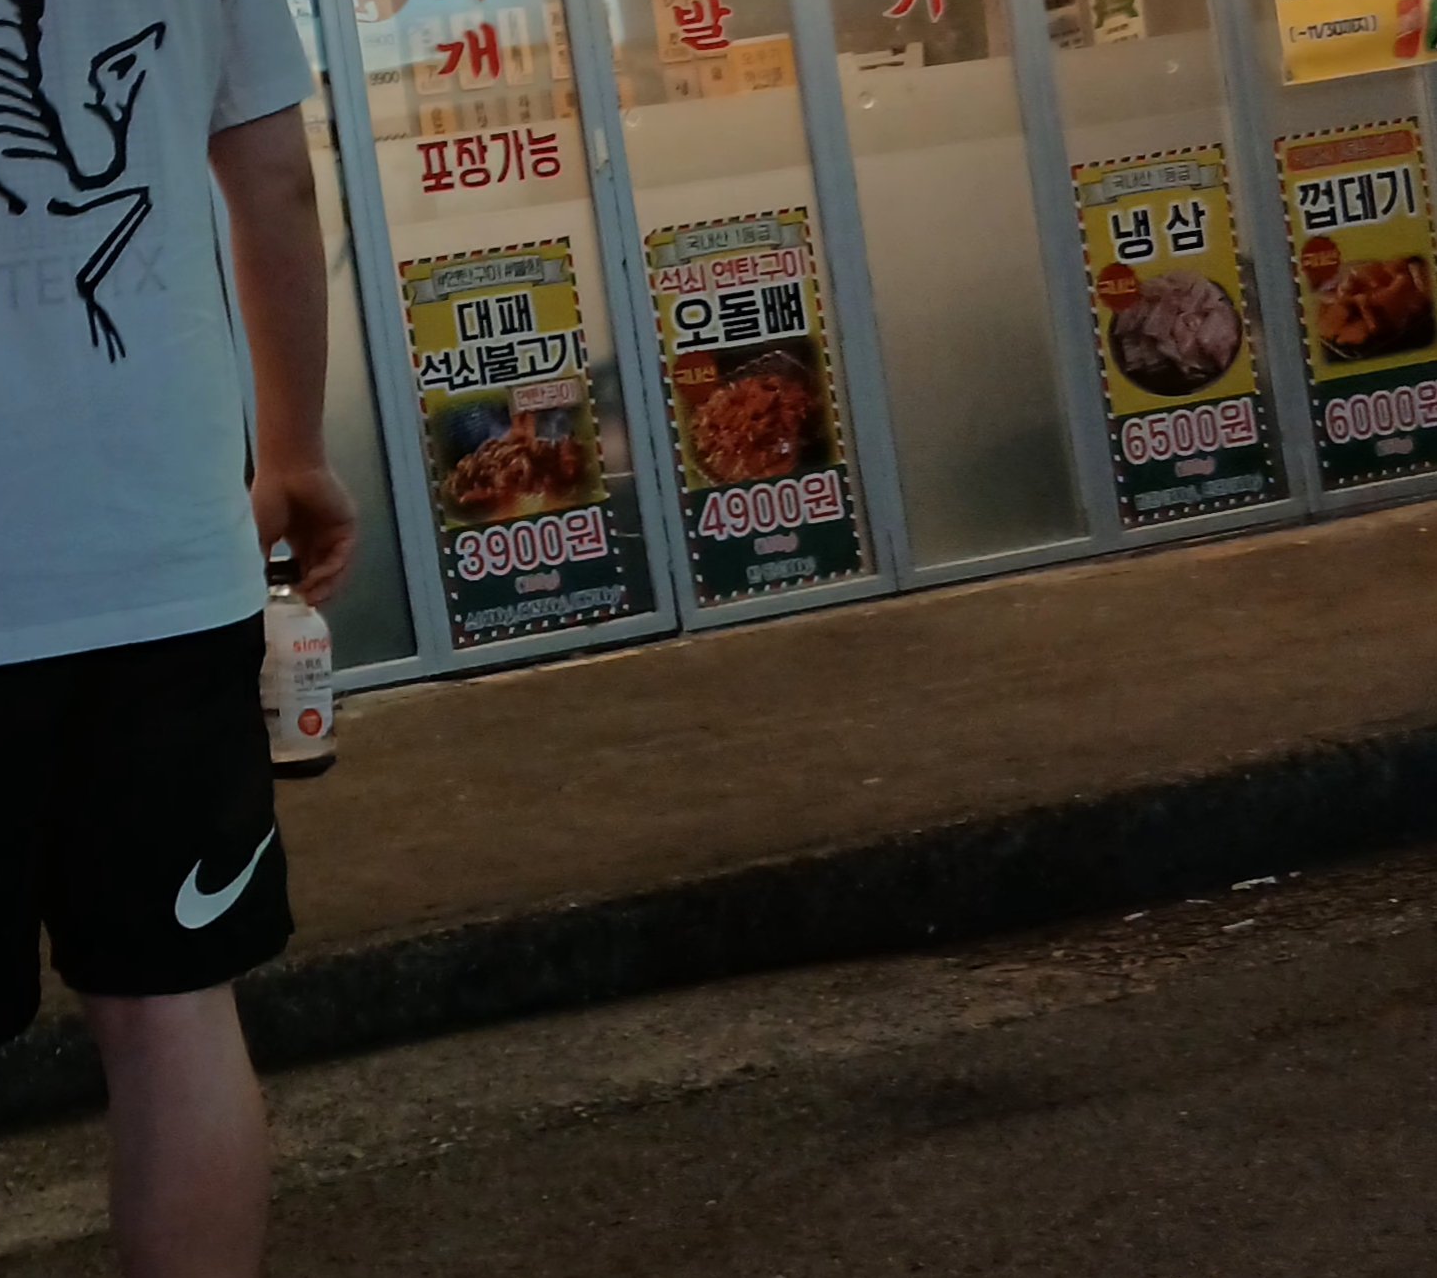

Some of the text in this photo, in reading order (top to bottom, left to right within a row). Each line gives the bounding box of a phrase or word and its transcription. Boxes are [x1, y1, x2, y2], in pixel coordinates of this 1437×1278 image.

[417, 127, 561, 193] 포장가능
[1298, 168, 1414, 230] 껍데기
[660, 249, 805, 294] 석쇠 연탄구이
[457, 293, 533, 341] 대패
[420, 330, 582, 390] 석쇠불고기
[1124, 399, 1256, 463] 6500원
[701, 472, 842, 538] 4900원
[457, 508, 606, 578] 3900원
